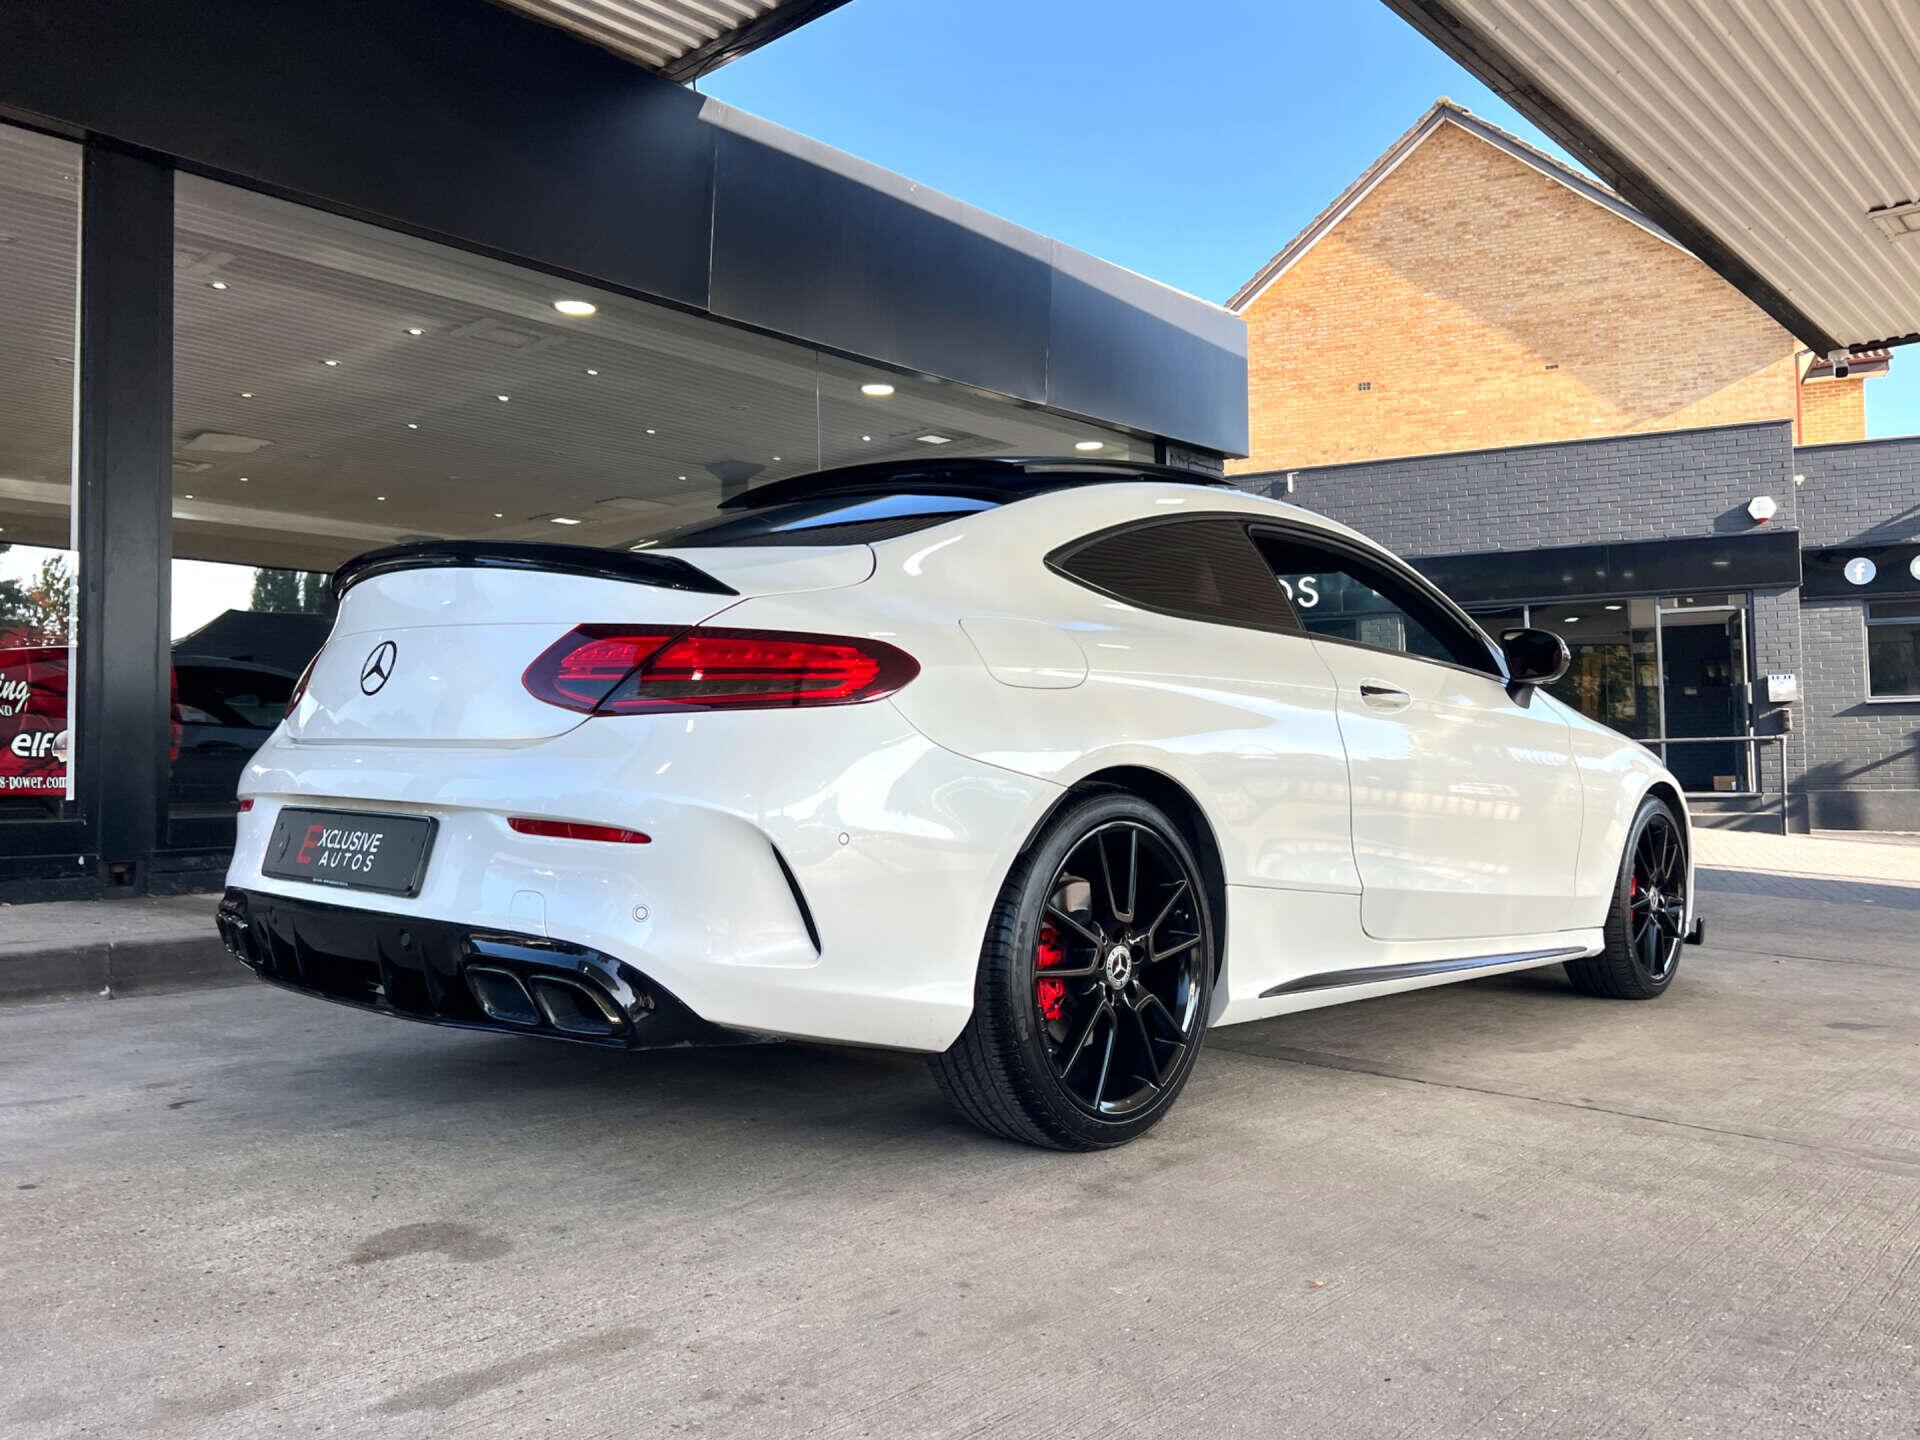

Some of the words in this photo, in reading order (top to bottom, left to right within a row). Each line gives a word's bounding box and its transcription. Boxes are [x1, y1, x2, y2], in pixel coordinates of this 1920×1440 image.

[10, 731, 55, 757] elf
[296, 823, 384, 864] EXCLUSIVE
[318, 850, 375, 872] AUTOS
